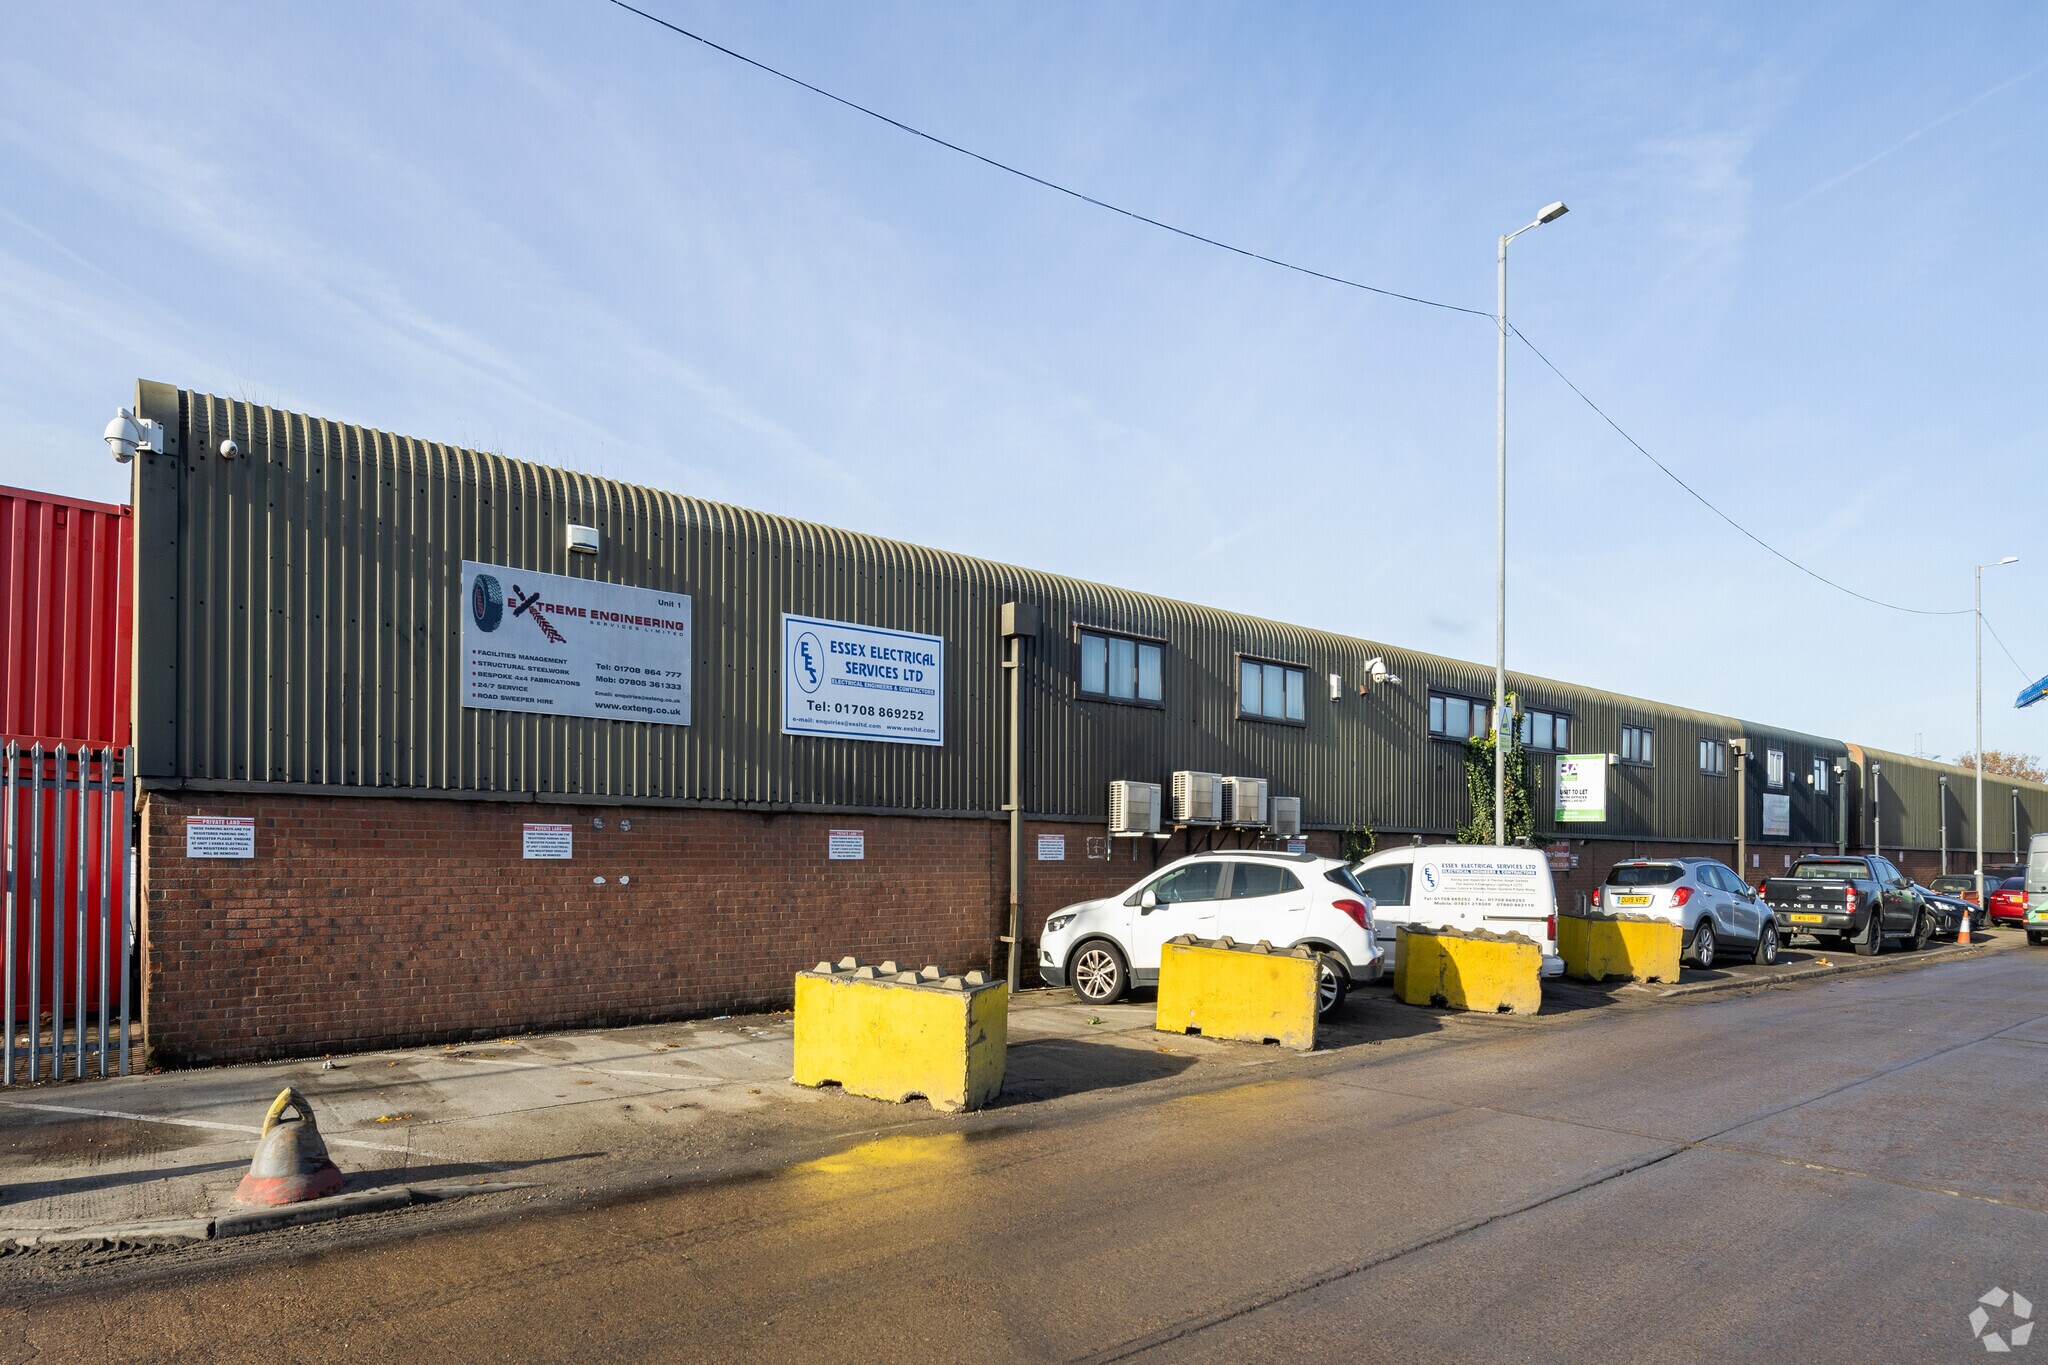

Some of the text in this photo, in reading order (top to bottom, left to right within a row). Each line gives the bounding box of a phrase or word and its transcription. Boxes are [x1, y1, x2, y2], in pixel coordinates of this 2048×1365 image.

[658, 599, 674, 607] Unit
[591, 610, 684, 631] ENGINEERING
[590, 620, 684, 637] SERVICES LIMITED
[478, 649, 567, 664] FACILITIES MANAGEMENT
[830, 640, 935, 666] ESSEX ELECTRICAL
[478, 660, 570, 675] STRUCTURAL STEELWORK
[614, 665, 640, 674] 01708
[845, 662, 923, 682] SERVICES LTD
[478, 672, 512, 680] BESPOKE
[530, 676, 580, 686] FABRICATIONS
[619, 678, 646, 686] 07805
[649, 681, 681, 690] 361333
[831, 678, 863, 688] ELECTRICAL
[864, 682, 893, 691] ENGINEERS
[898, 686, 935, 695] CONTRACTORS
[500, 694, 535, 703] SWEEPER
[595, 702, 681, 715] www.exteng.co.uk
[807, 700, 924, 720] Tel: 01708 869252
[816, 719, 881, 729] enquiries@eesltd.com
[887, 725, 935, 734] www.eesltd.com
